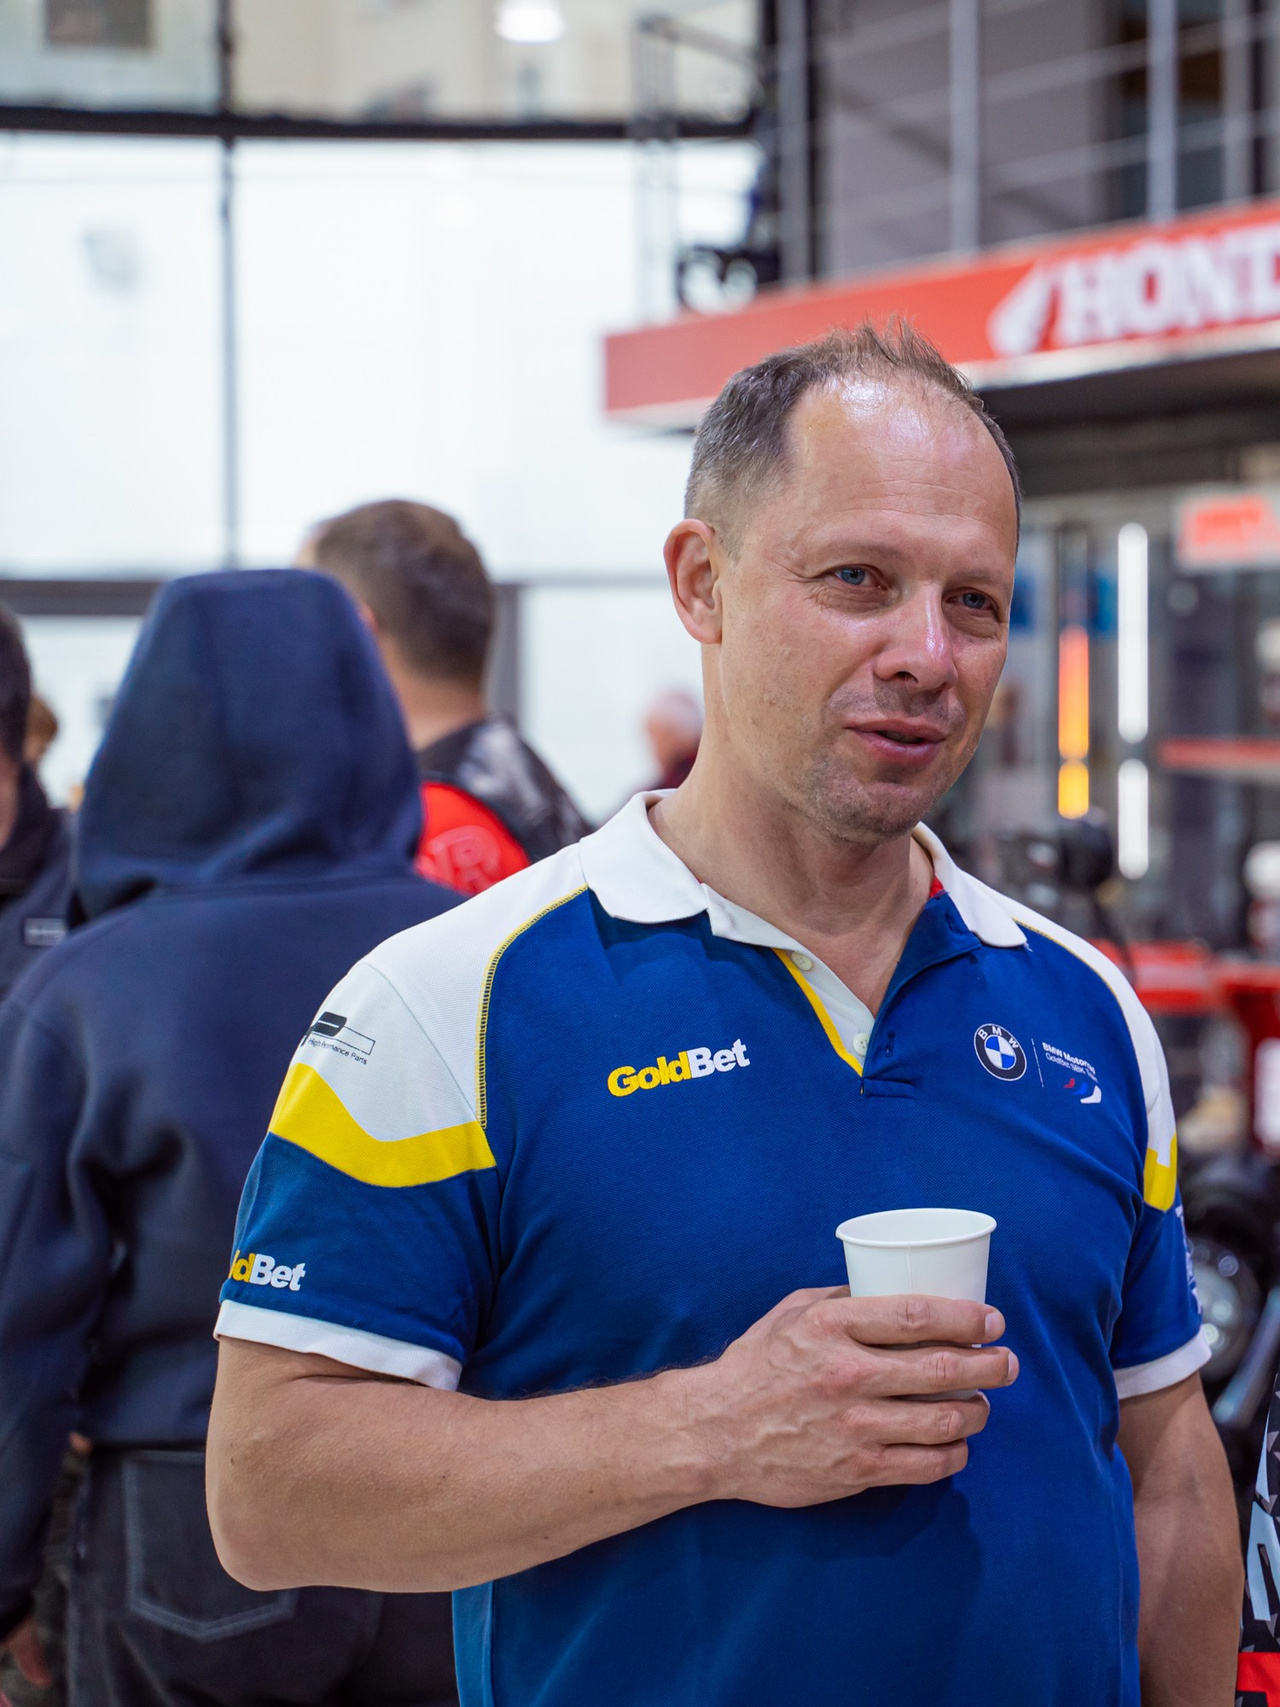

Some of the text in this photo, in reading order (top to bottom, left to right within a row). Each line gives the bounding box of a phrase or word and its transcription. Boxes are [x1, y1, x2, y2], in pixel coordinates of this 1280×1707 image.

[977, 1025, 1019, 1049] BMW
[1042, 1042, 1063, 1058] BMW
[607, 1038, 751, 1097] GoldBet
